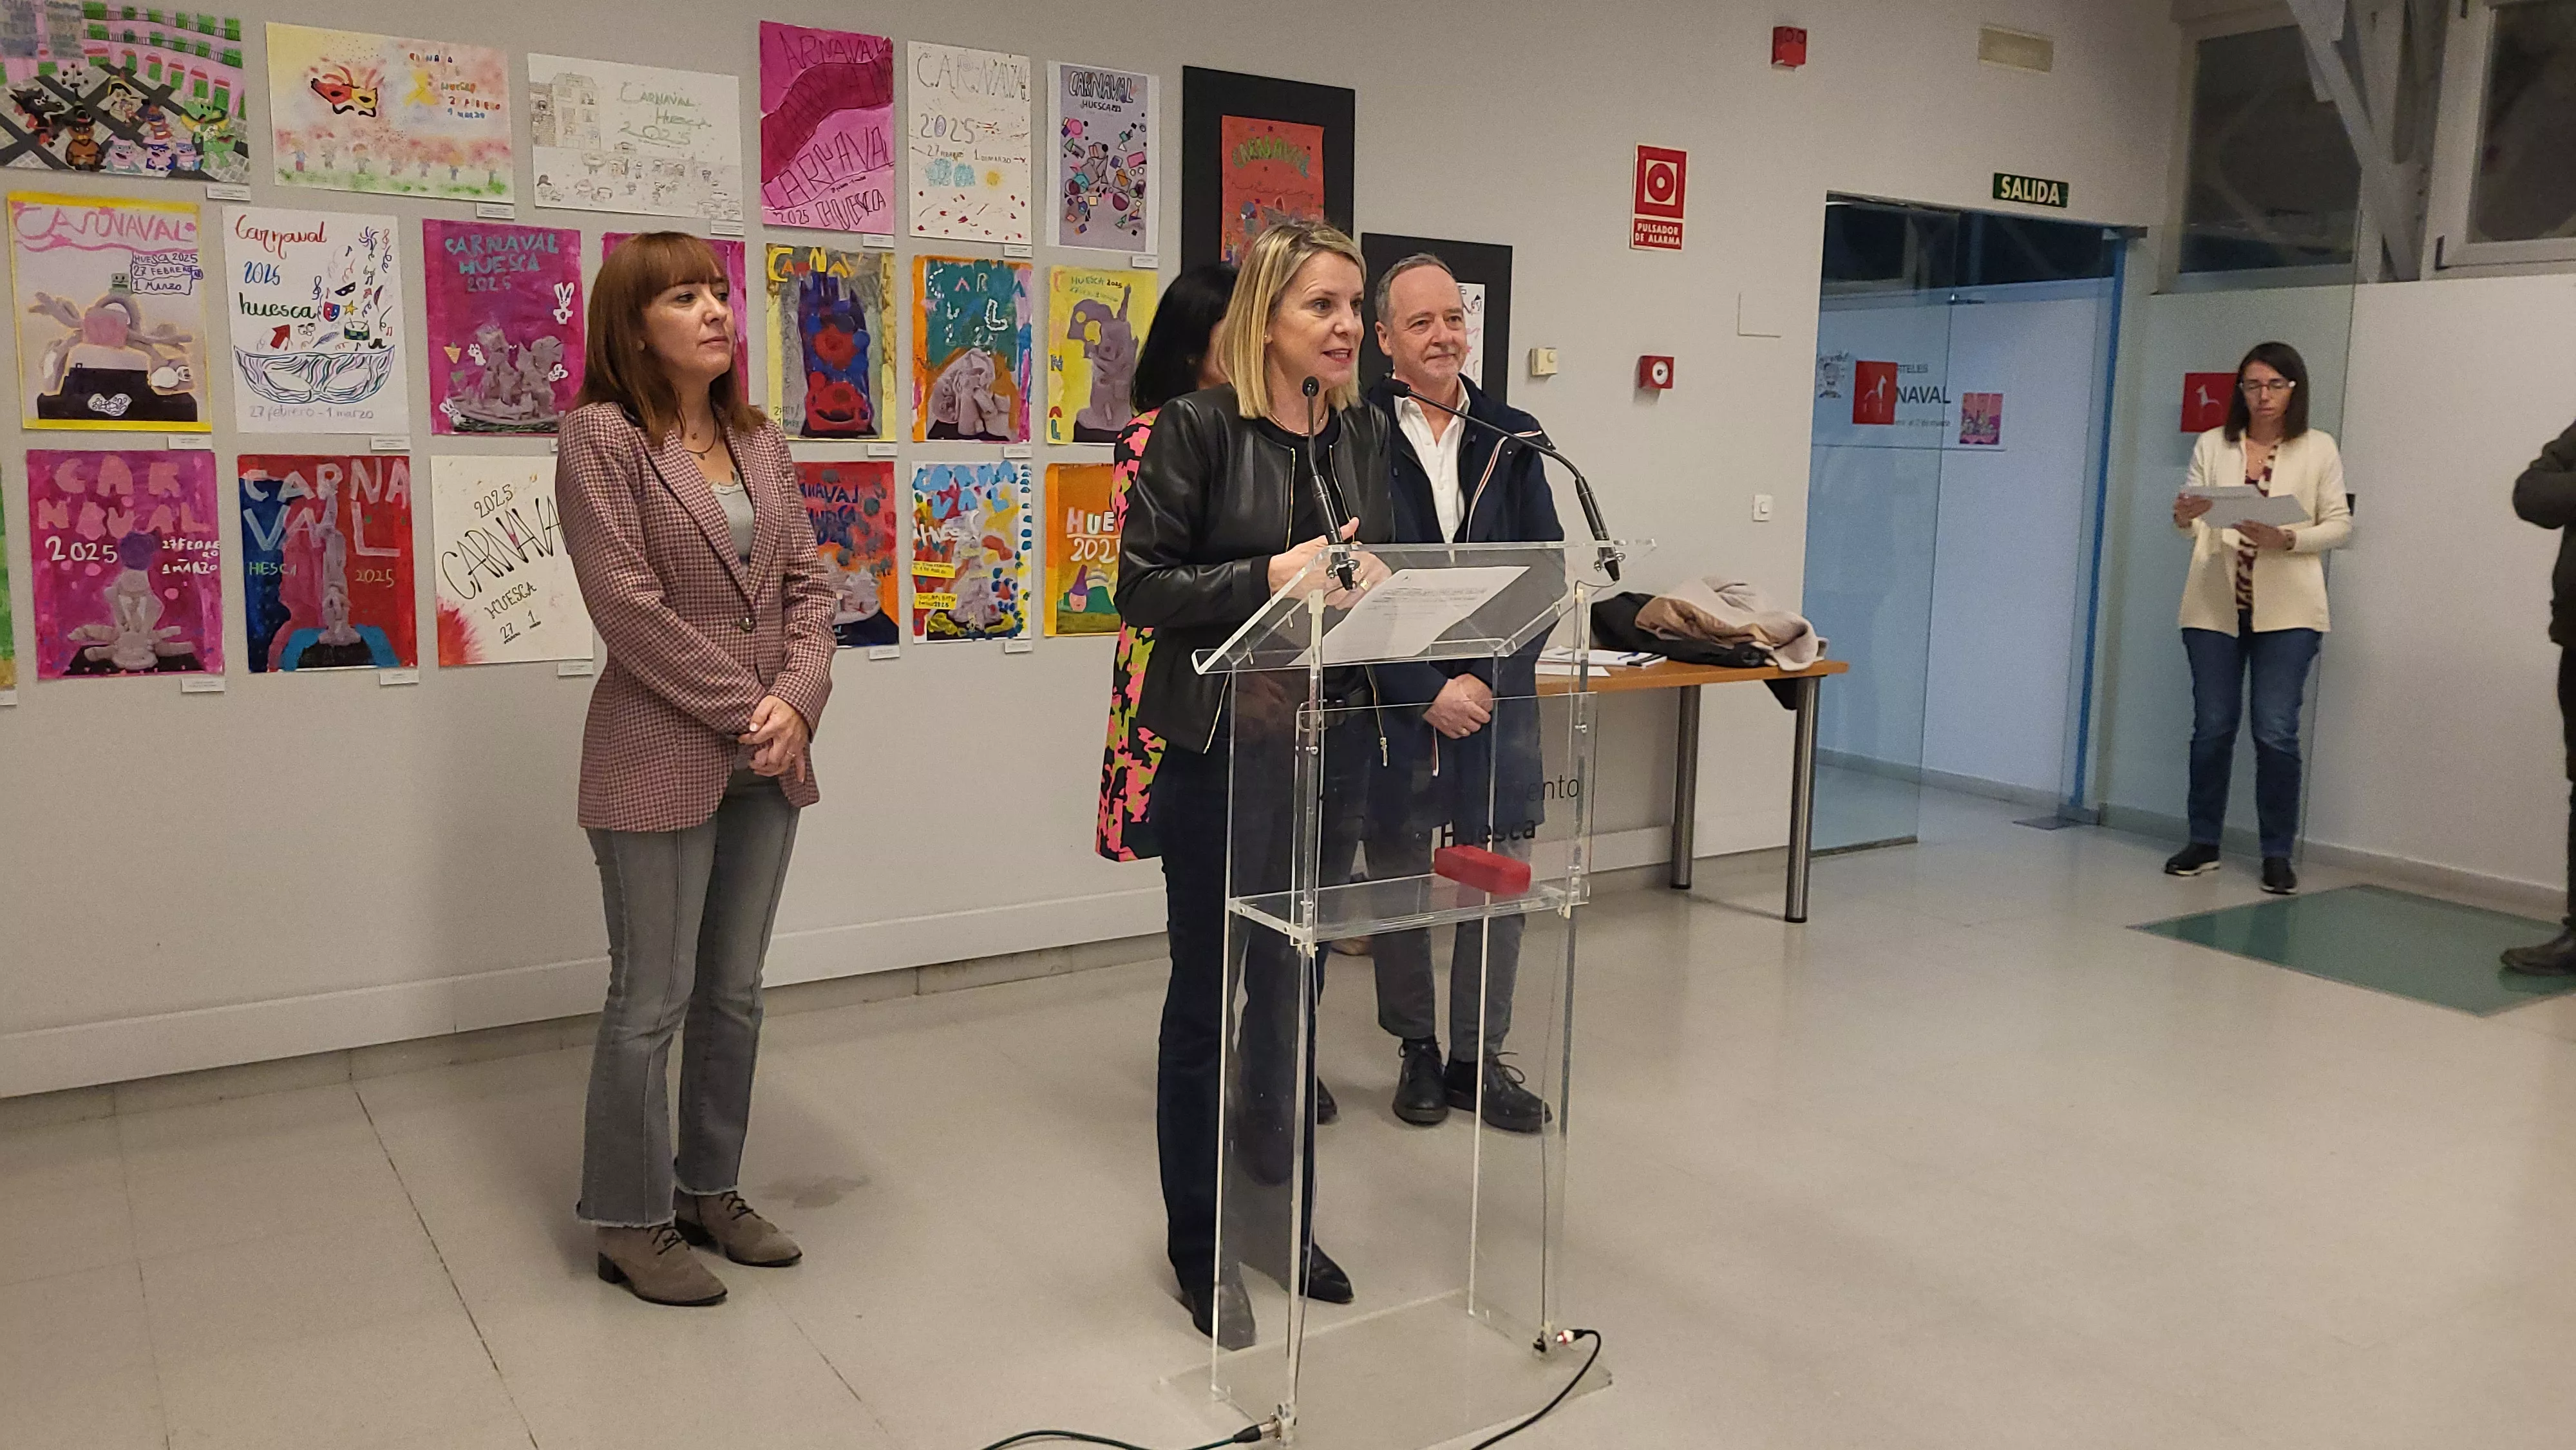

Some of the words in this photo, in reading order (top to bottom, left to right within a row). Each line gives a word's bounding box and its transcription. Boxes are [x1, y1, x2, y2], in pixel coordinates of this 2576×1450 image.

[920, 113, 976, 145] 2025
[2001, 175, 2060, 205] SALIDA
[1635, 232, 1644, 242] DE
[1648, 234, 1681, 246] ALARMA
[1637, 222, 1679, 236] PULSADOR
[445, 233, 559, 255] CARNAVAL
[134, 254, 169, 265] HUESCA
[172, 252, 198, 263] 2025
[459, 254, 541, 275] HUESCA
[133, 265, 146, 276] 27
[1895, 386, 1951, 404] NAVAL
[474, 484, 514, 518] 2025
[1066, 507, 1115, 535] HUE
[46, 536, 118, 563] 2025
[1070, 538, 1121, 563] 202
[355, 569, 395, 587] 2025
[484, 581, 538, 619] HUESCA
